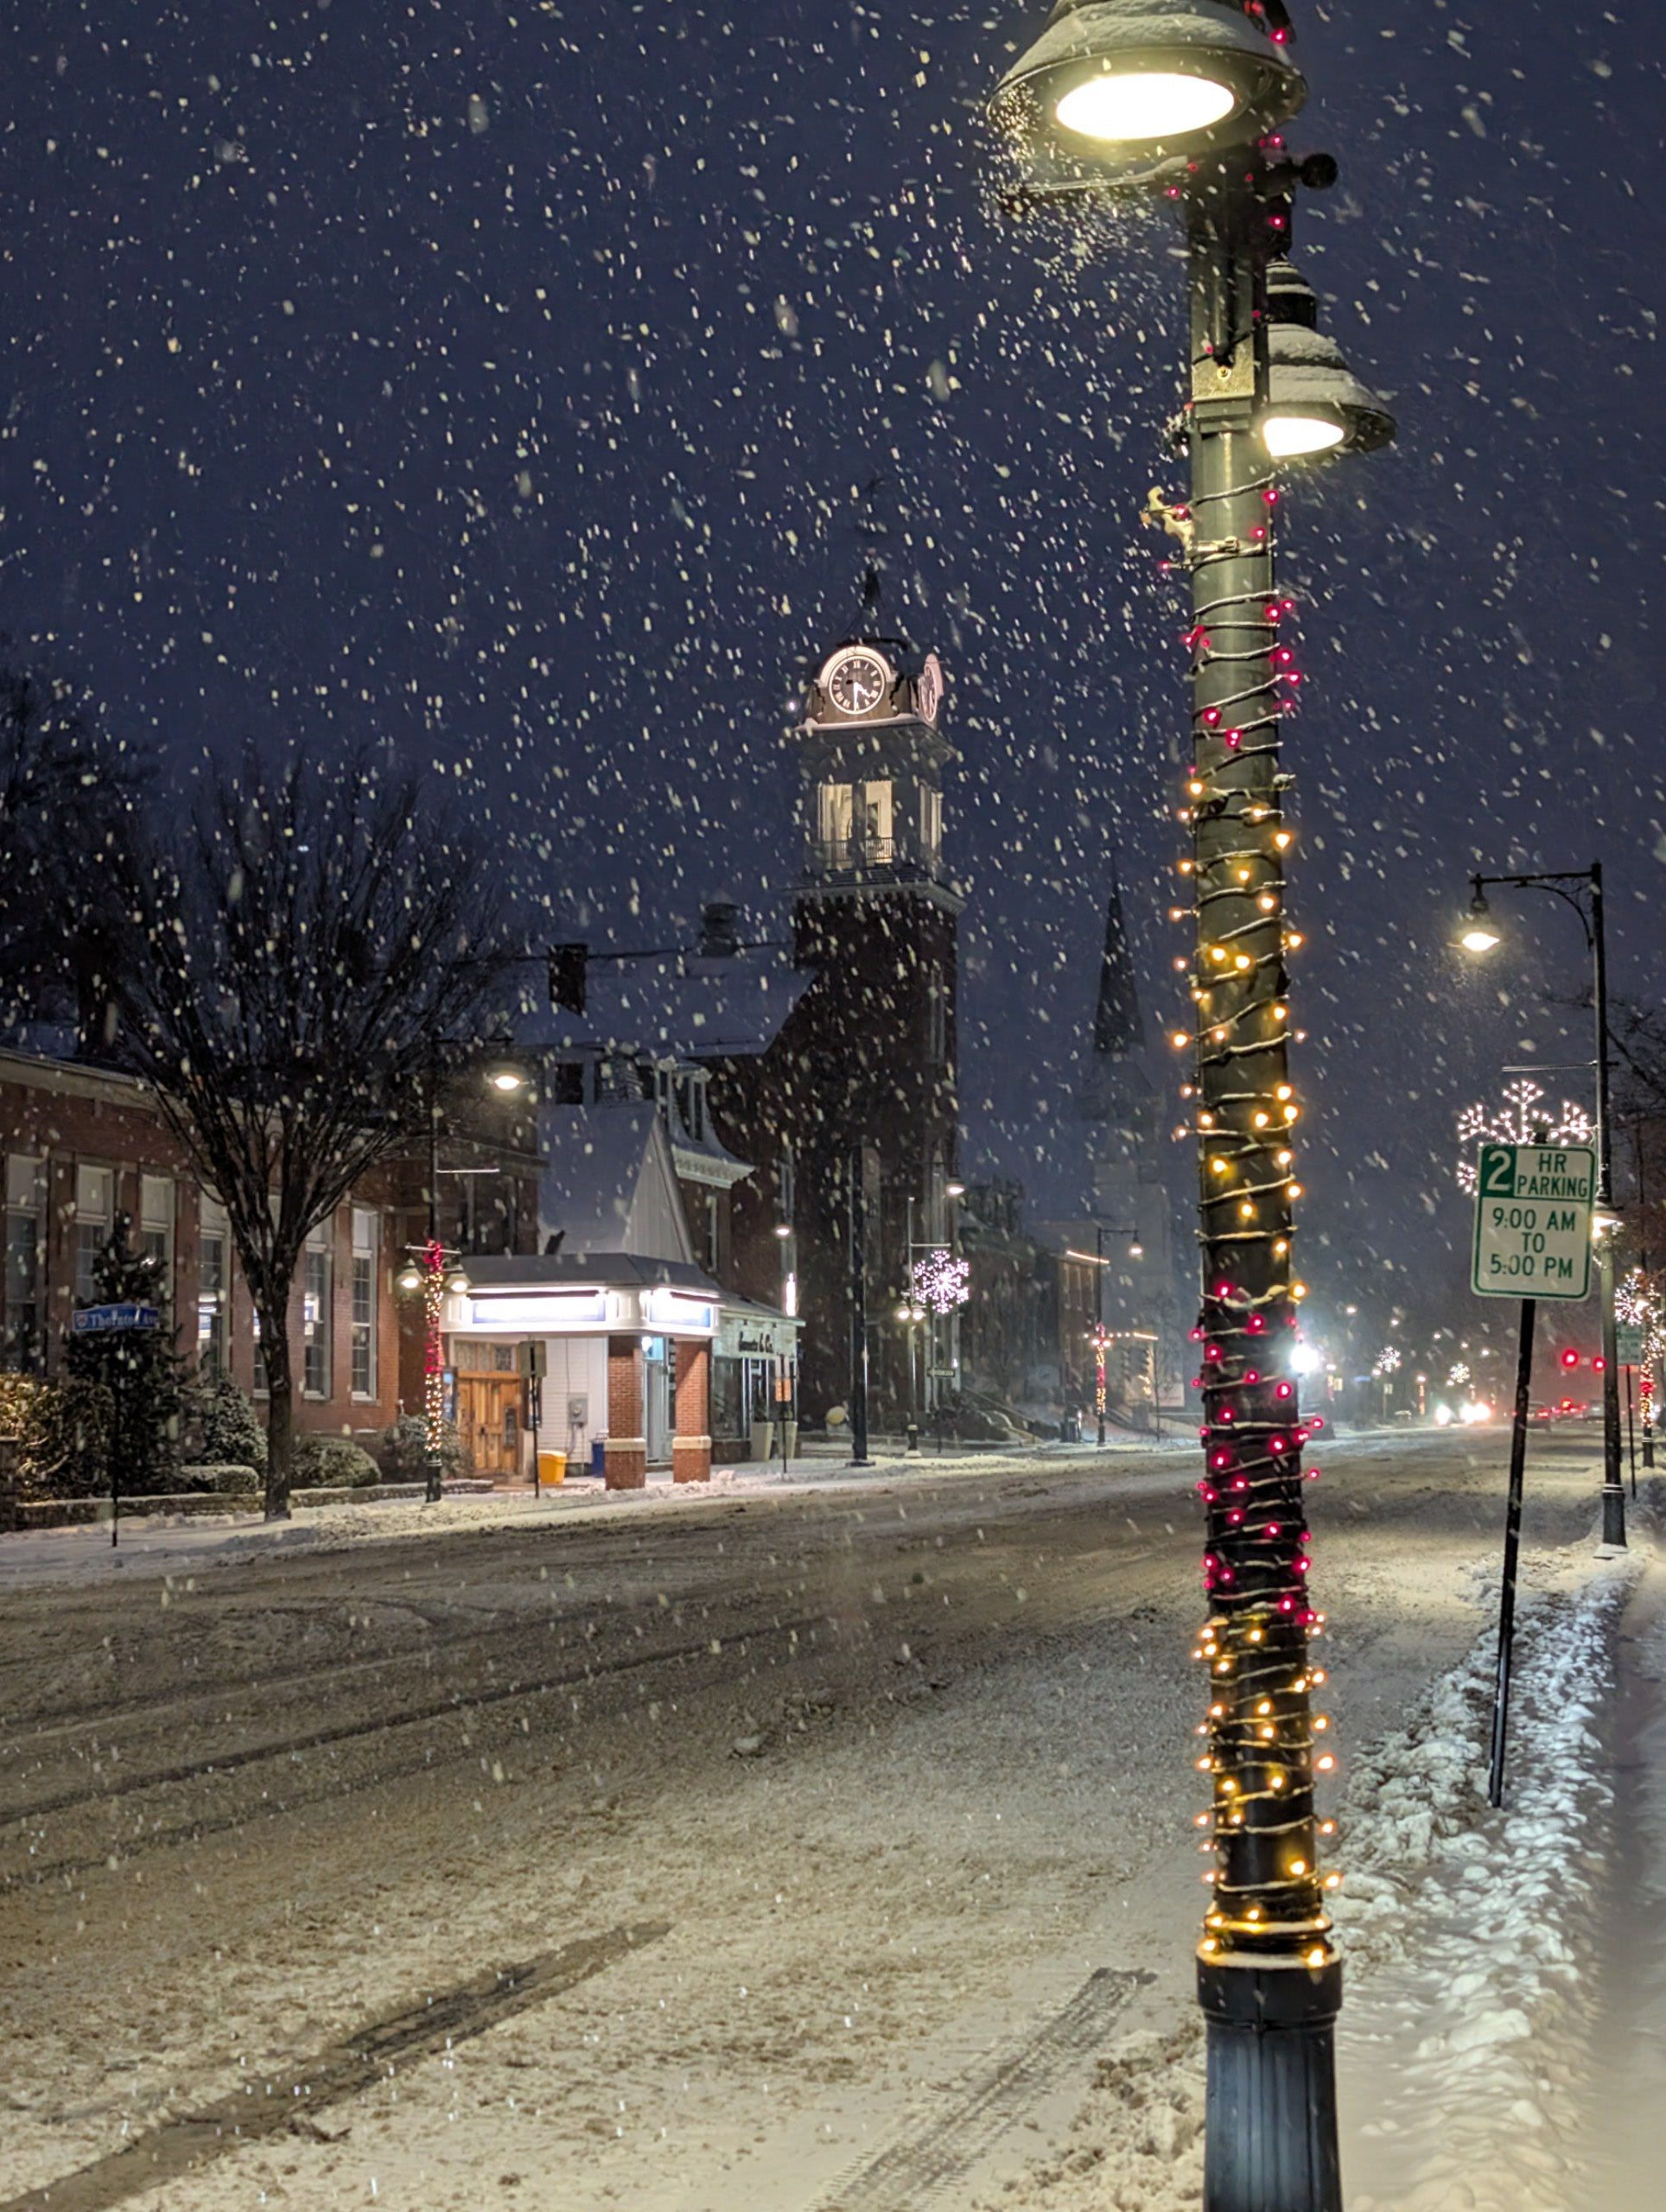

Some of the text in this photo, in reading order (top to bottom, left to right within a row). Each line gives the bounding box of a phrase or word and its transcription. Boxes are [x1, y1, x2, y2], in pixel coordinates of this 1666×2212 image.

[1486, 1150, 1511, 1191] 2
[1538, 1153, 1567, 1173] HR
[1517, 1175, 1587, 1197] PARKING
[1492, 1207, 1576, 1231] 9:00 AM
[1522, 1232, 1545, 1253] TO
[1491, 1254, 1573, 1278] 5:00 PM
